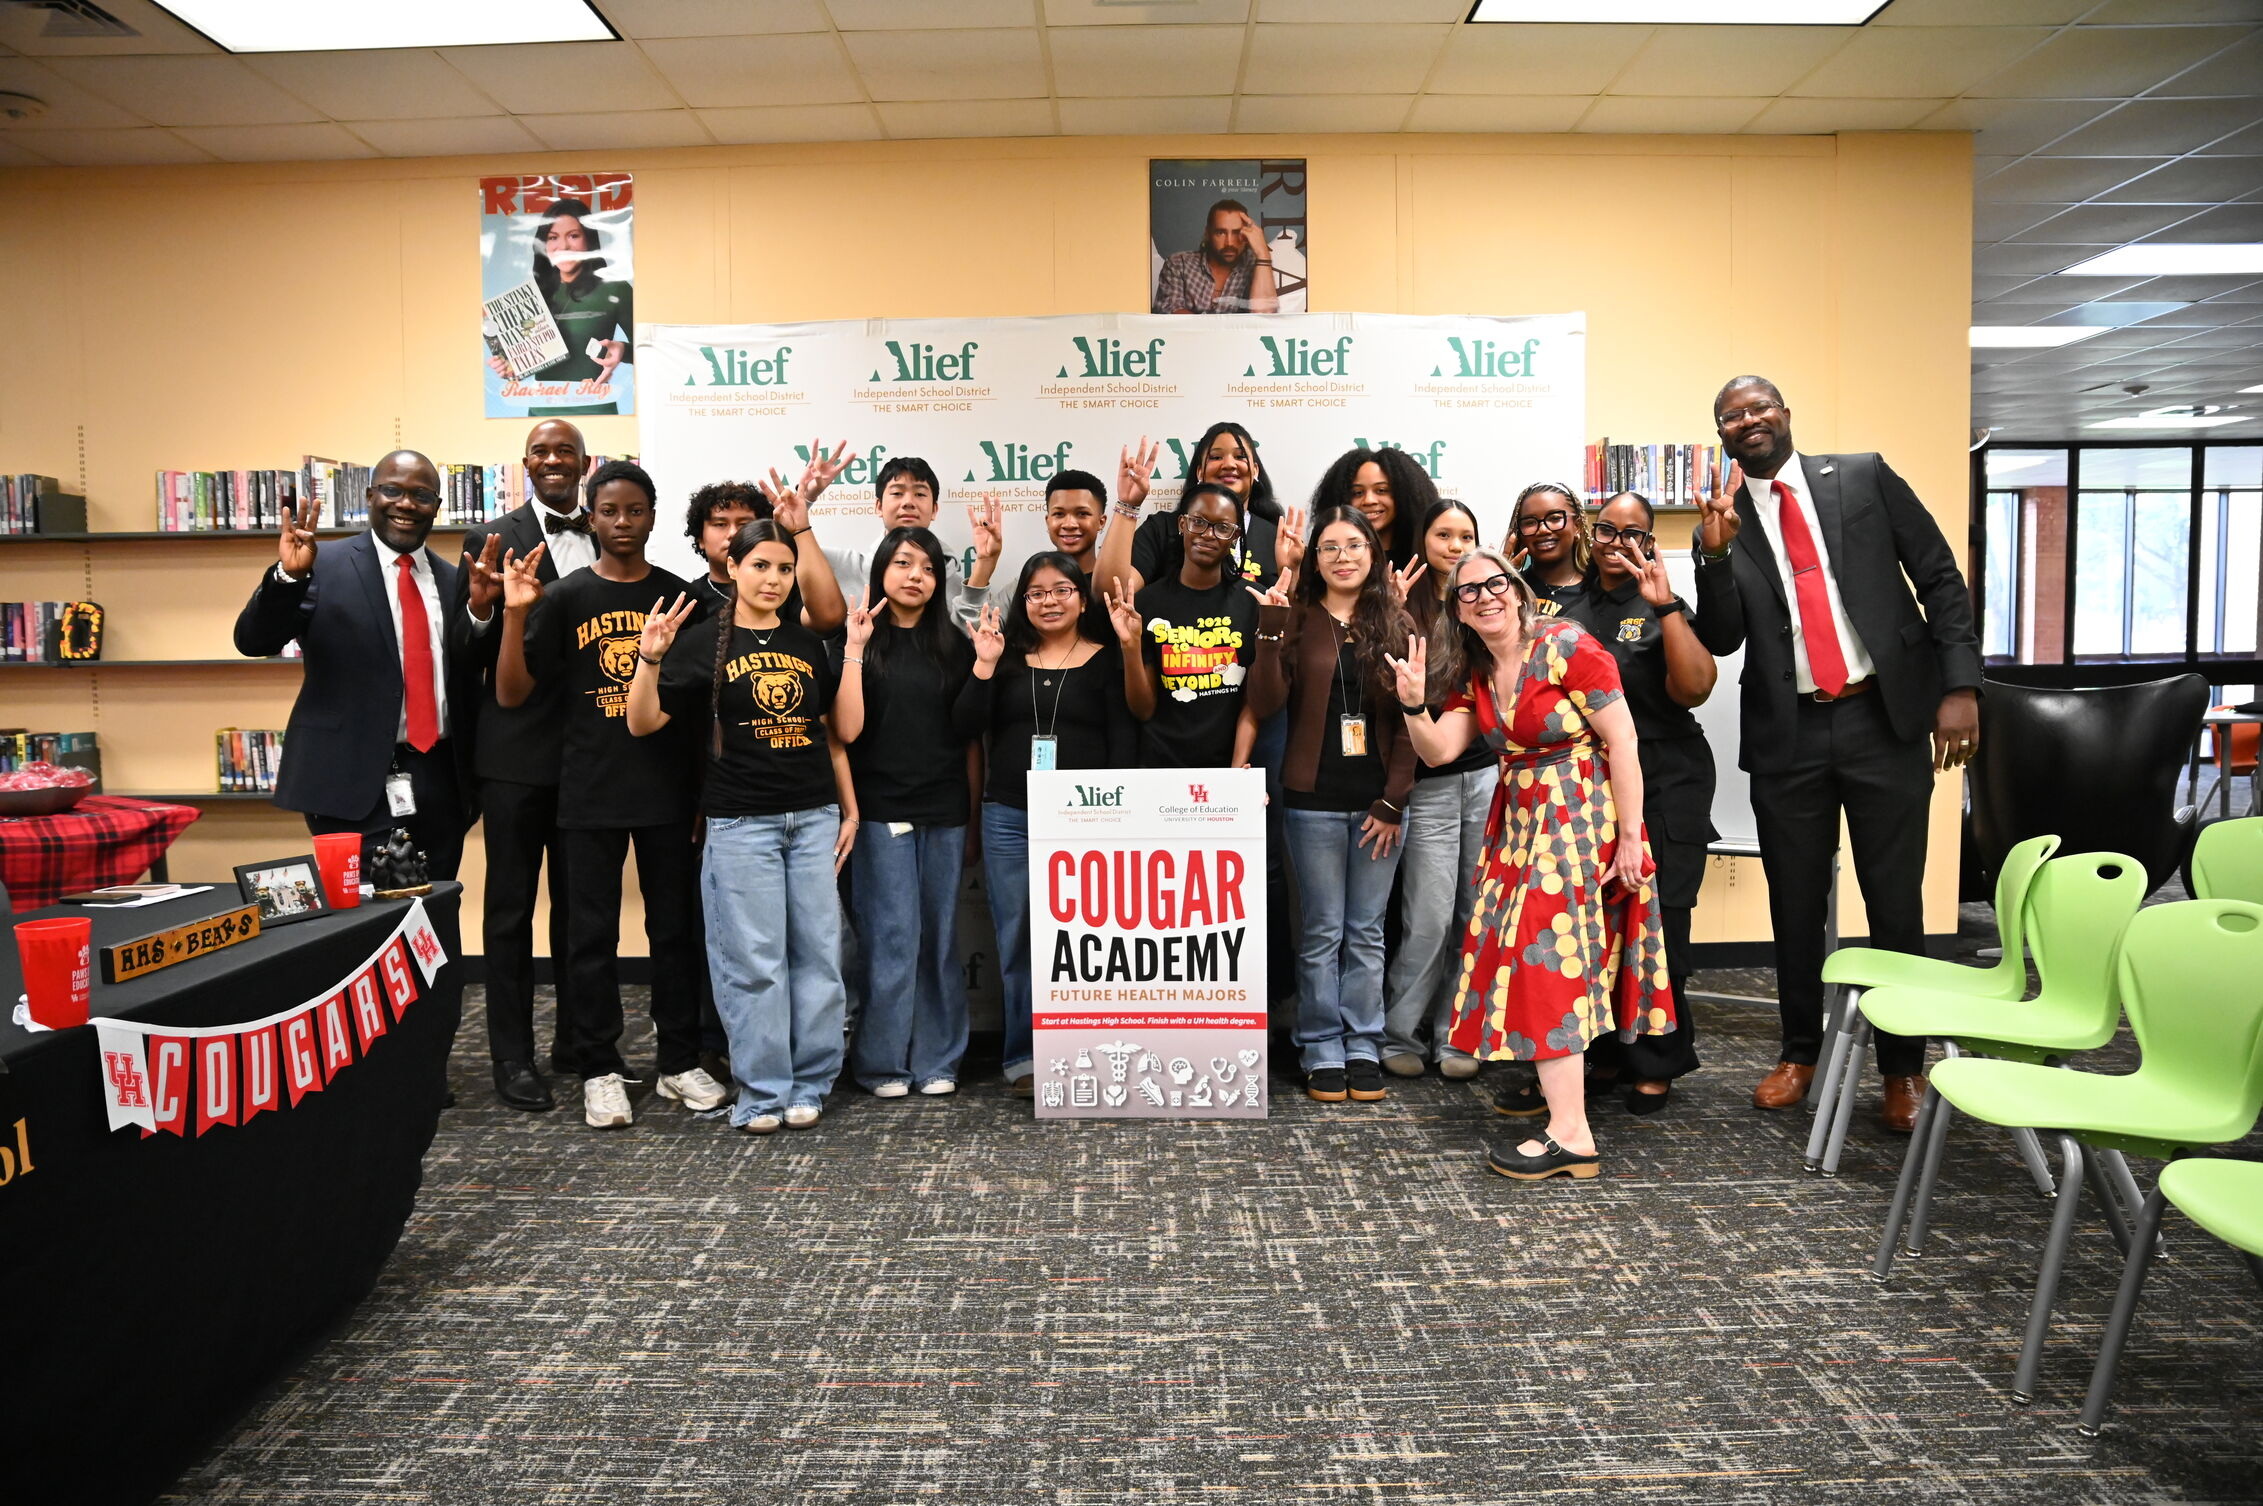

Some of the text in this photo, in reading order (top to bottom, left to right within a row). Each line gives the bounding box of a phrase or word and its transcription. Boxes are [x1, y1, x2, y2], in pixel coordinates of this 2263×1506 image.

[1155, 178, 1260, 188] COLIN FARRELL
[1261, 160, 1308, 300] REA
[504, 283, 535, 306] STINKY
[493, 297, 545, 334] CHEESE
[511, 348, 547, 373] TALES
[869, 341, 979, 382] Alief
[1056, 336, 1166, 378] Alief
[1243, 336, 1353, 376] Alief
[1430, 337, 1540, 377] Alief
[684, 346, 793, 386] Alief
[575, 377, 613, 400] Ray
[853, 386, 991, 400] Independent School District
[1040, 382, 1177, 396] Independent School District
[1227, 381, 1365, 394] Independent School District
[1414, 383, 1551, 395] Independent School District
[669, 391, 804, 404] Independent School District
[1060, 399, 1159, 409] THE SMART CHOICE
[1247, 398, 1347, 408] THE SMART CHOICE
[1434, 399, 1533, 408] THE SMART CHOICE
[689, 407, 787, 417] THE SMART CHOICE
[874, 402, 972, 413] THE SMART CHOICE
[963, 441, 1073, 482] Alief
[828, 490, 862, 501] School
[1014, 486, 1047, 497] Schoo
[810, 507, 837, 516] MART
[1028, 503, 1049, 512] CHO
[1153, 502, 1173, 511] THE
[1197, 616, 1232, 628] 2026
[576, 610, 651, 650] HASTIN
[1163, 651, 1236, 668] INFINITY
[1214, 665, 1228, 673] AND
[598, 685, 619, 695] HIGH
[1199, 688, 1229, 697] HASTINGS
[601, 696, 623, 705] CLASS
[751, 717, 773, 726] HIGH
[760, 728, 783, 736] CLASS
[771, 735, 813, 749] OFFIC
[1066, 784, 1125, 807] Alief
[1189, 783, 1209, 803] UH
[1159, 805, 1239, 815] College of Education
[1048, 849, 1246, 930] COUGAR
[186, 913, 253, 955] BEARS
[1050, 926, 1247, 983] ACADEMY
[1051, 988, 1247, 1001] FUTURE HEALTH MAJORS
[105, 926, 440, 1124] UH COUGARS UH
[1041, 1017, 1060, 1025] Start
[1061, 1017, 1069, 1025] at
[1070, 1017, 1101, 1026] Hastings
[1102, 1017, 1119, 1026] High
[1120, 1017, 1146, 1025] School.
[1147, 1017, 1169, 1025] Finish
[1170, 1017, 1187, 1025] with
[1194, 1017, 1205, 1025] UH
[1205, 1017, 1229, 1025] health
[1230, 1017, 1257, 1027] degree.
